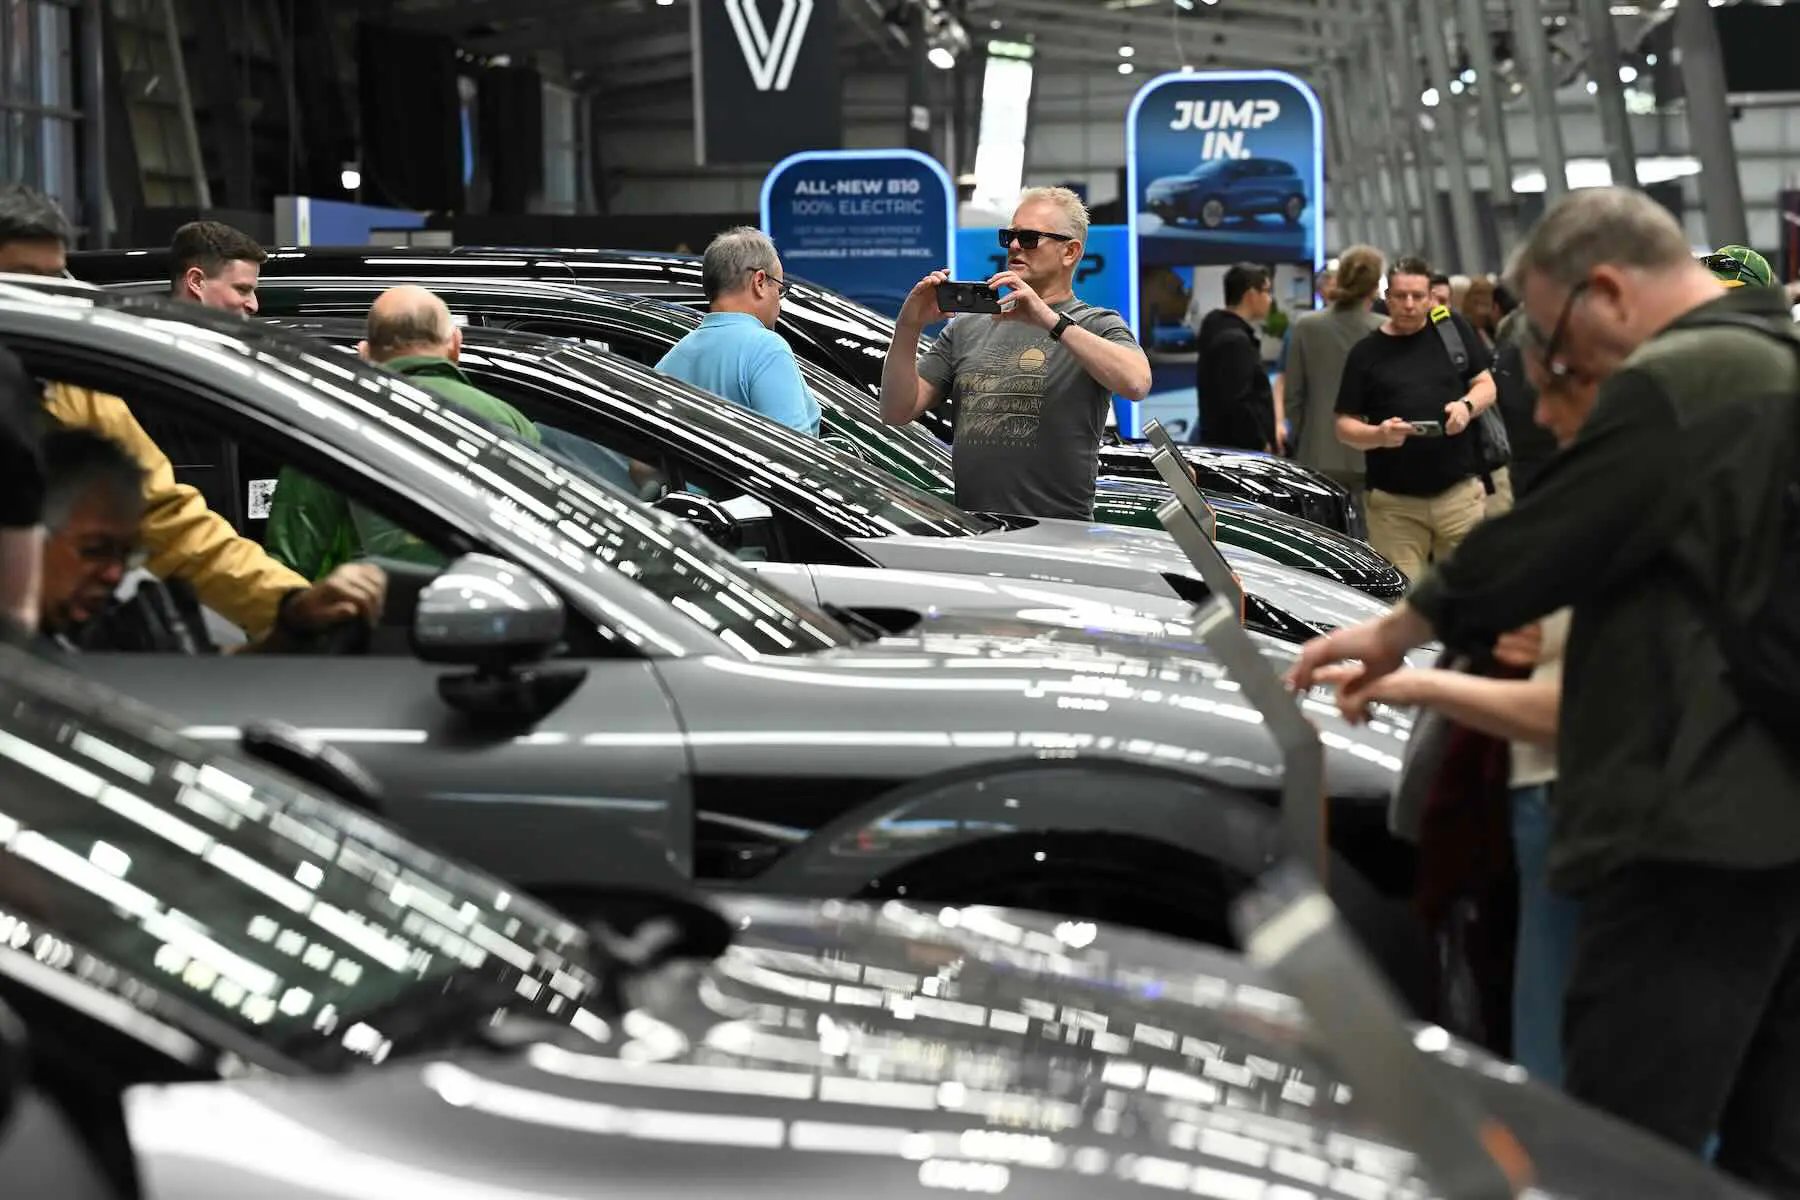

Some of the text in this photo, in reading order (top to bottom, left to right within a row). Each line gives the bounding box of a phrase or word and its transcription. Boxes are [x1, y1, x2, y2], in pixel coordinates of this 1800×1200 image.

[1169, 99, 1281, 130] JUMP
[1201, 131, 1252, 160] IN.
[795, 179, 920, 195] ALL-NEW B10
[792, 199, 924, 215] 100% ELECTRIC
